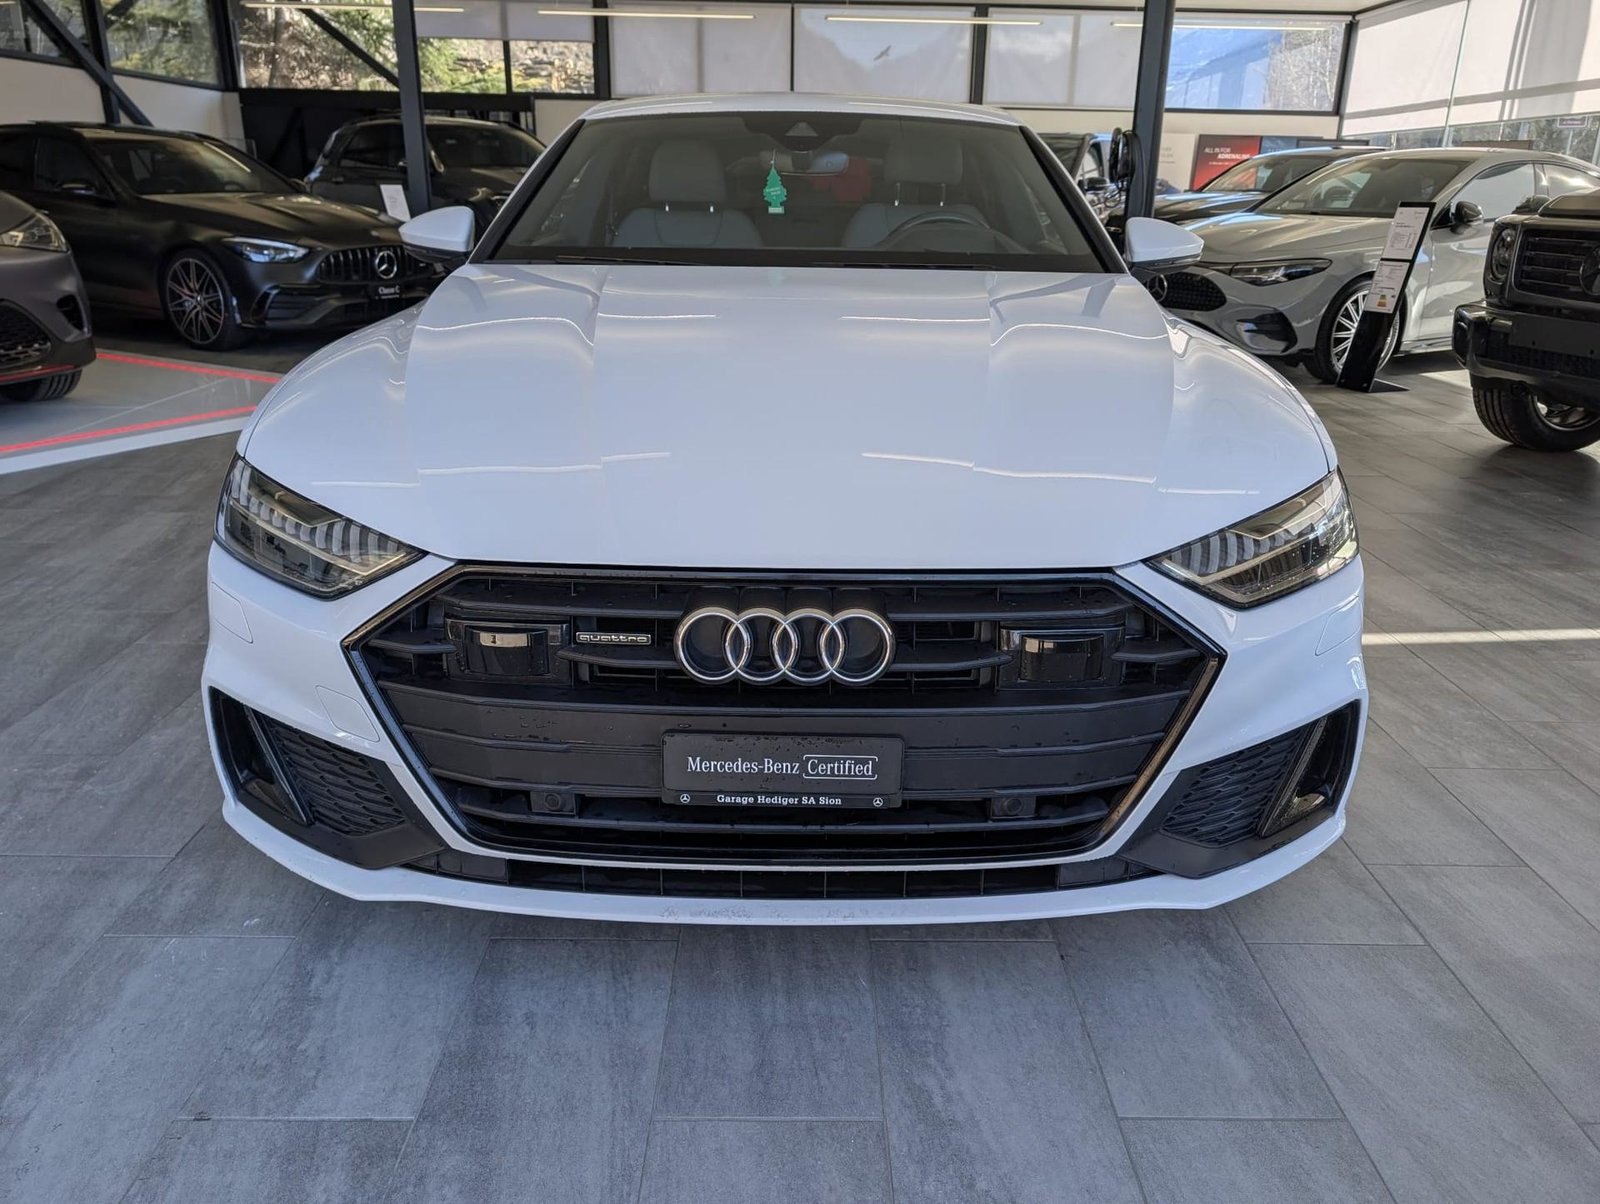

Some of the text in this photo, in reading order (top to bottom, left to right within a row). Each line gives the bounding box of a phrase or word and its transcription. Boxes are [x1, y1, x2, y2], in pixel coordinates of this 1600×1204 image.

[687, 756, 873, 775] Mercedes-Benz Certified
[717, 795, 842, 805] Garage Hediger SA Sion
